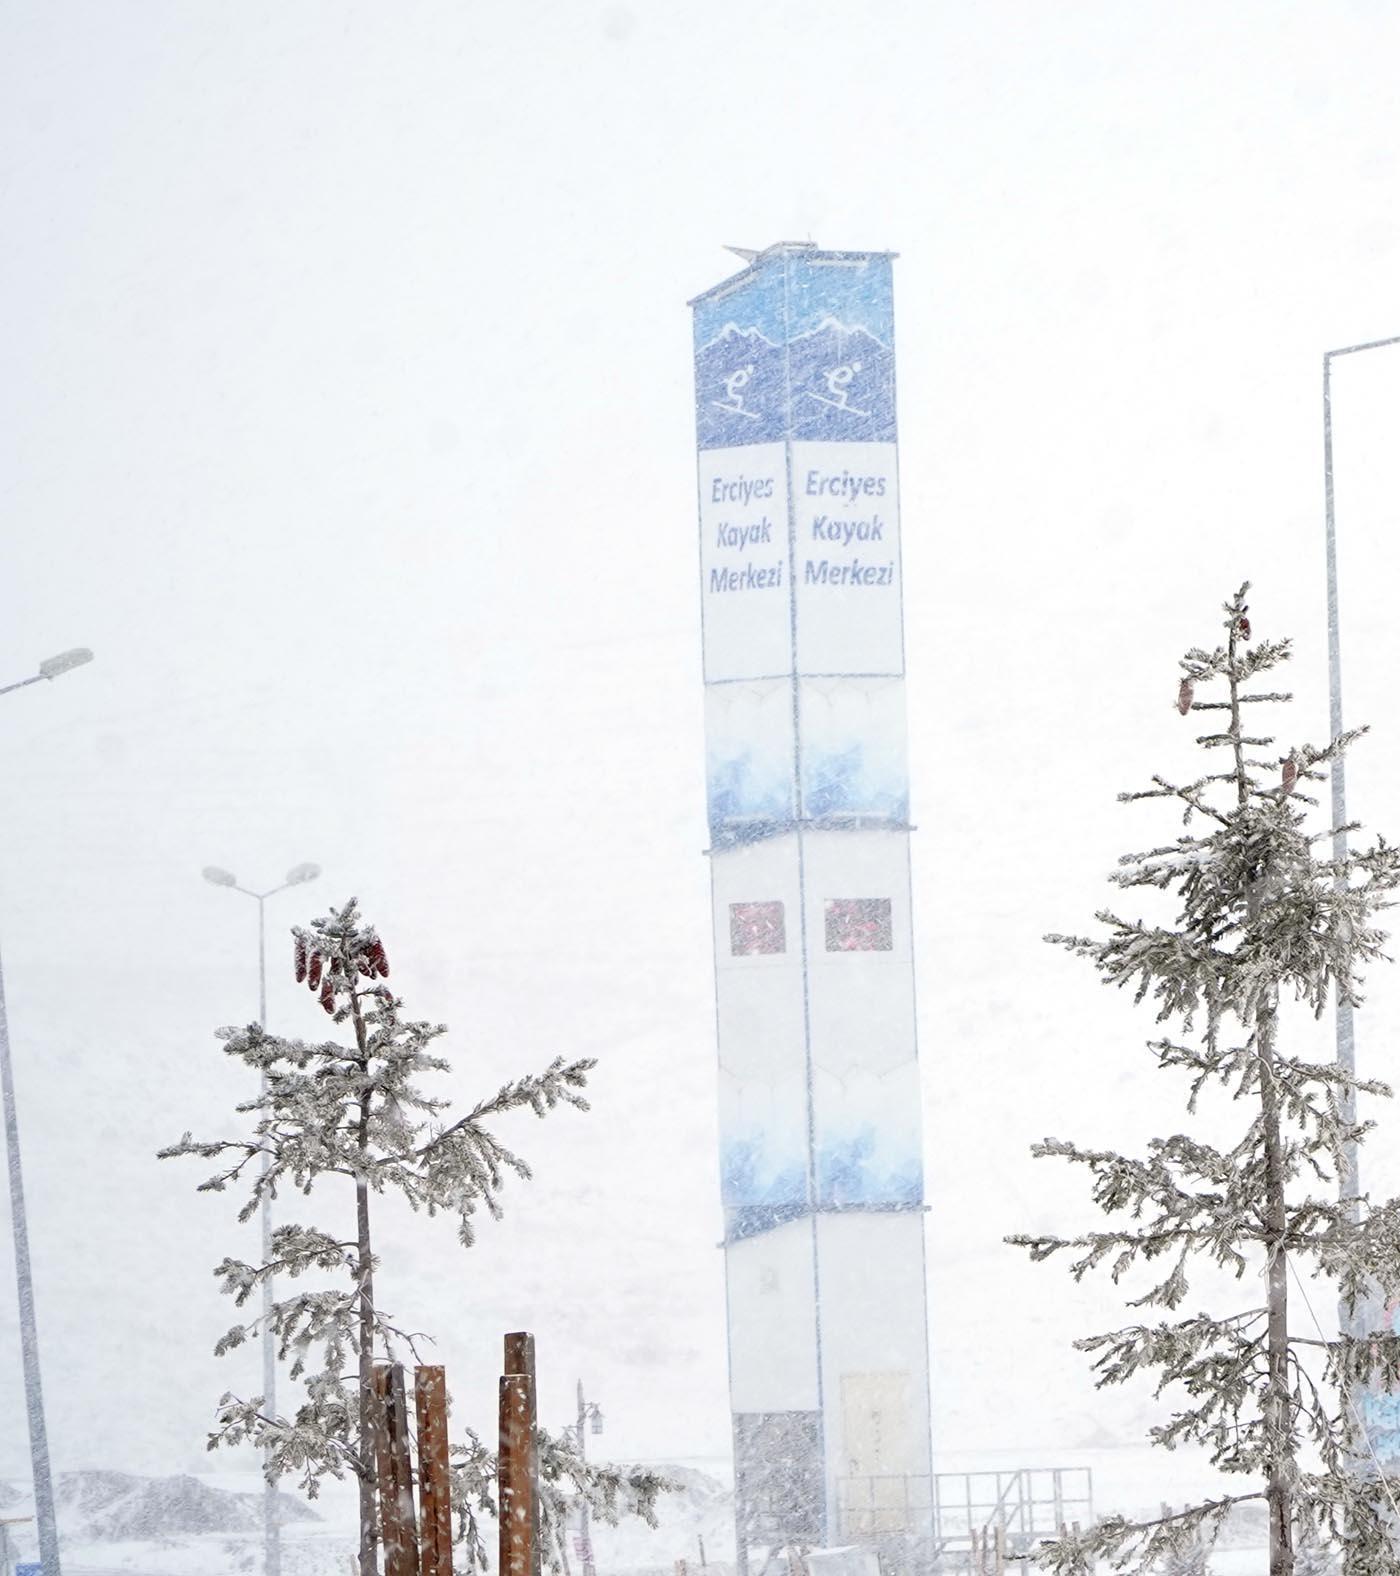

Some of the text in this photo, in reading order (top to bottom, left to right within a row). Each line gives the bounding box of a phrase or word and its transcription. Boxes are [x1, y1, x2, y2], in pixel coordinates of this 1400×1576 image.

[711, 475, 775, 507] Erciyes
[805, 470, 887, 503] Erciyes
[716, 516, 773, 552] Kayak
[812, 514, 884, 547] Kayak
[710, 560, 784, 594] Merkezi
[804, 558, 895, 587] Merkezi
